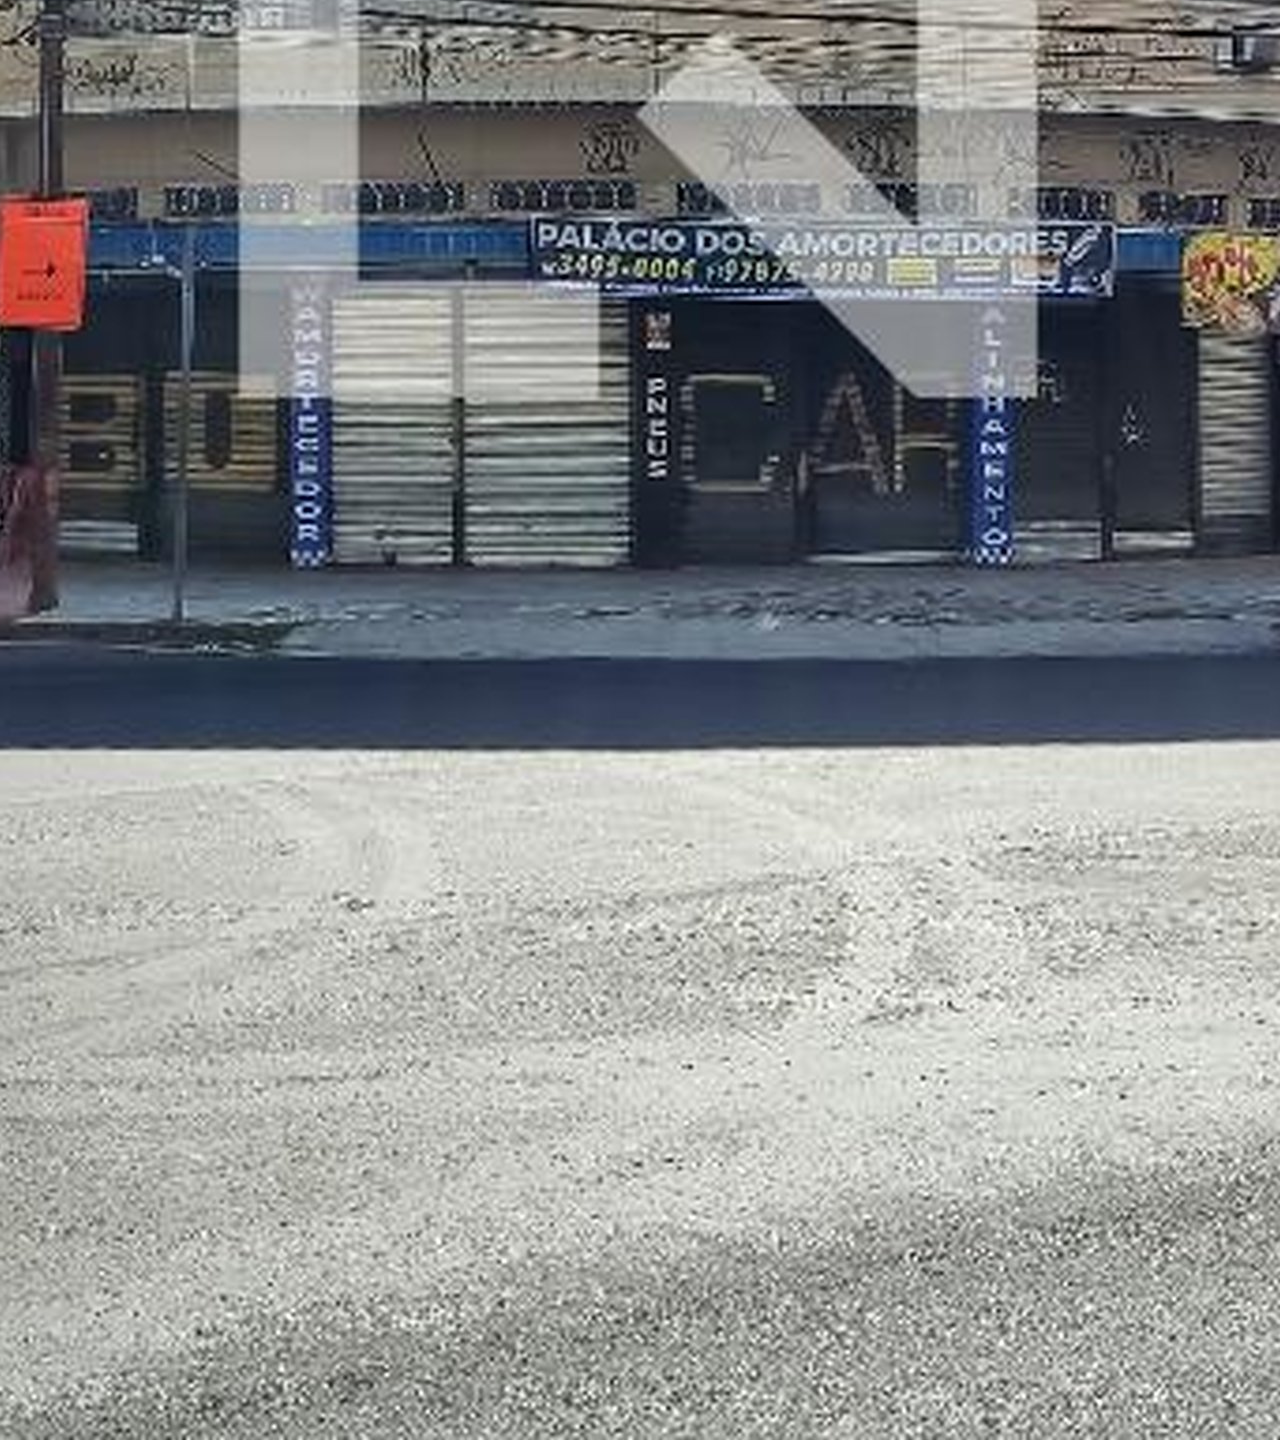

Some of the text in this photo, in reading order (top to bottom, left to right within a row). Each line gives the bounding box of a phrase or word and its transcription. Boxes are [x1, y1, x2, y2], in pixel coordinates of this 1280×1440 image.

[537, 219, 1068, 257] PALÁCIO DOS AMORTECEDORES
[646, 377, 668, 479] PNEUS
[980, 309, 1008, 545] ALINHAMENTO
